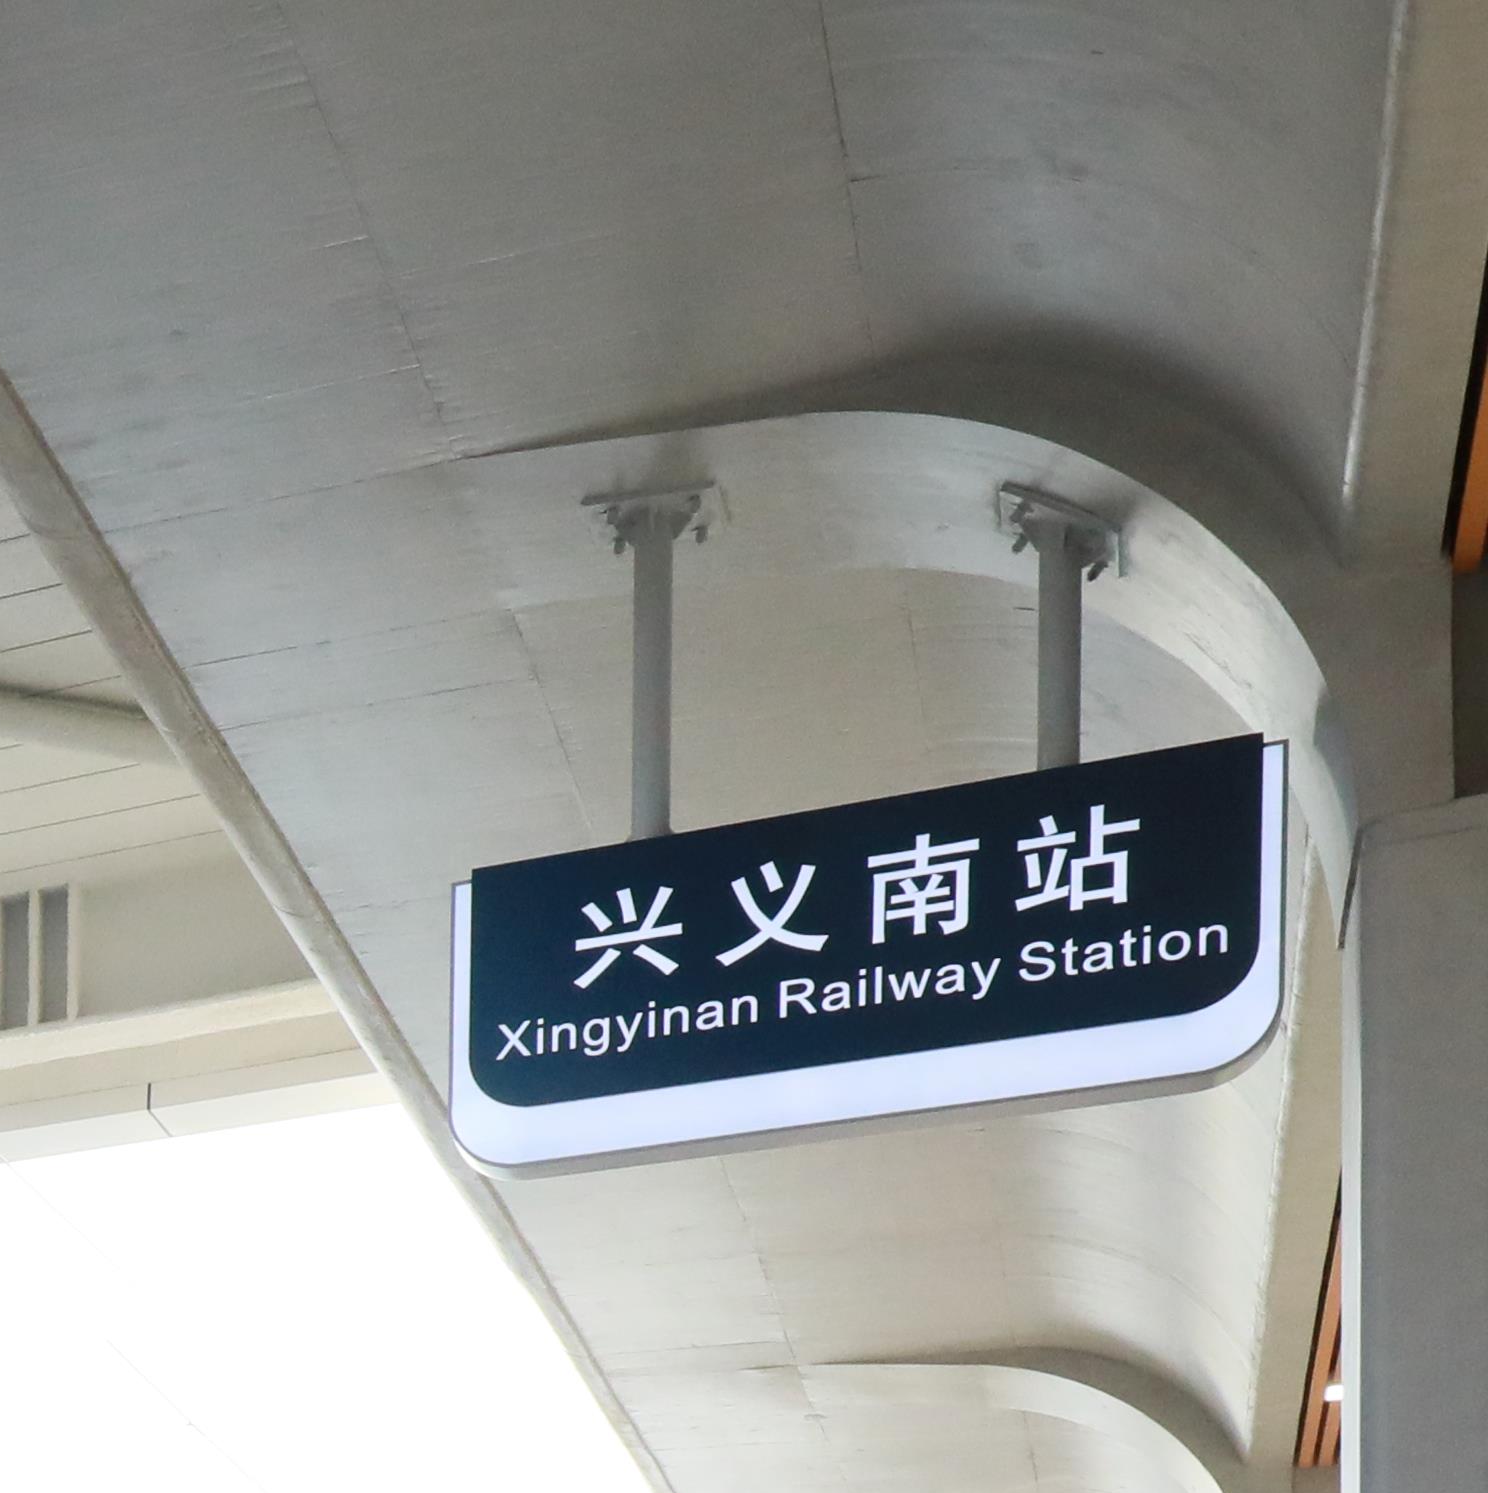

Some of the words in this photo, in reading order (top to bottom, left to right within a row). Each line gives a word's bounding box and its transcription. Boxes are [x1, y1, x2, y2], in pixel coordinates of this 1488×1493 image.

[573, 804, 1140, 989] 兴义南站
[495, 992, 759, 1061] Xingyinan
[779, 955, 1001, 1019] Railway
[1018, 920, 1229, 983] Station
